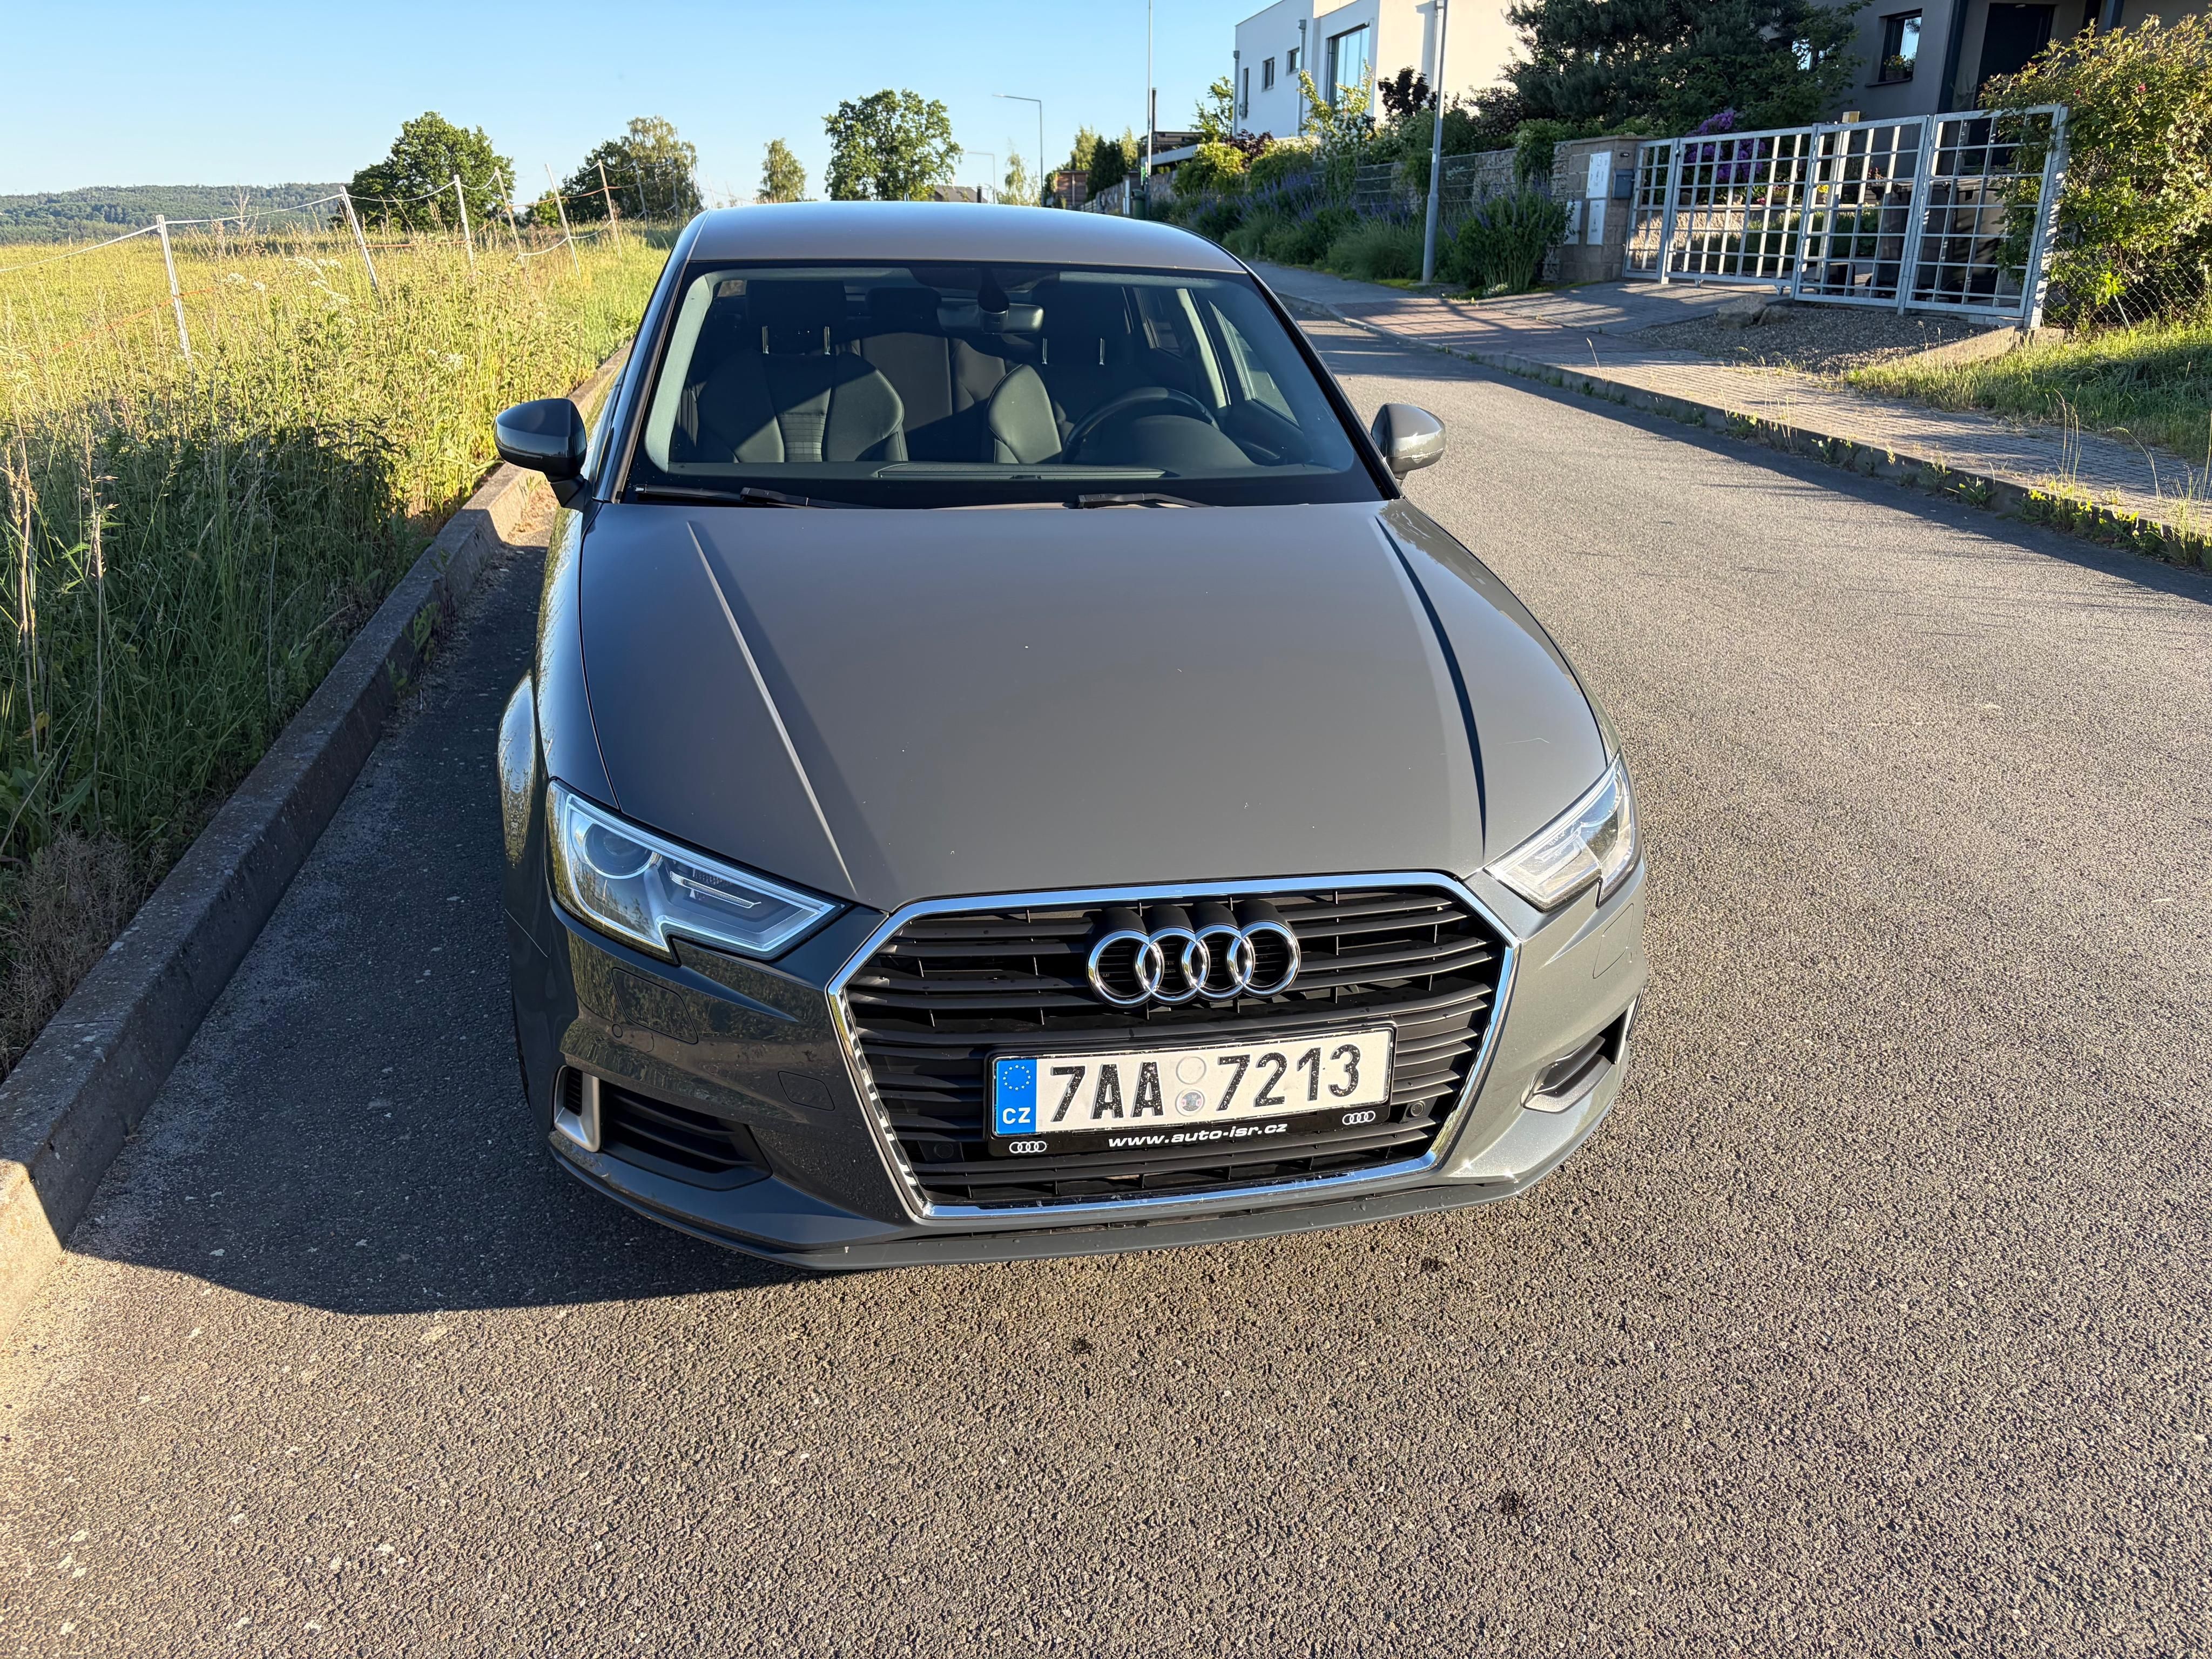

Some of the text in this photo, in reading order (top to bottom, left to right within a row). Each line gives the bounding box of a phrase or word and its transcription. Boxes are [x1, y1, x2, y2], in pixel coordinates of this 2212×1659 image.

[1049, 1043, 1361, 1122] 7AA 7213
[1002, 1107, 1030, 1124] CZ
[1109, 1123, 1287, 1147] www.auto-isr.cz
